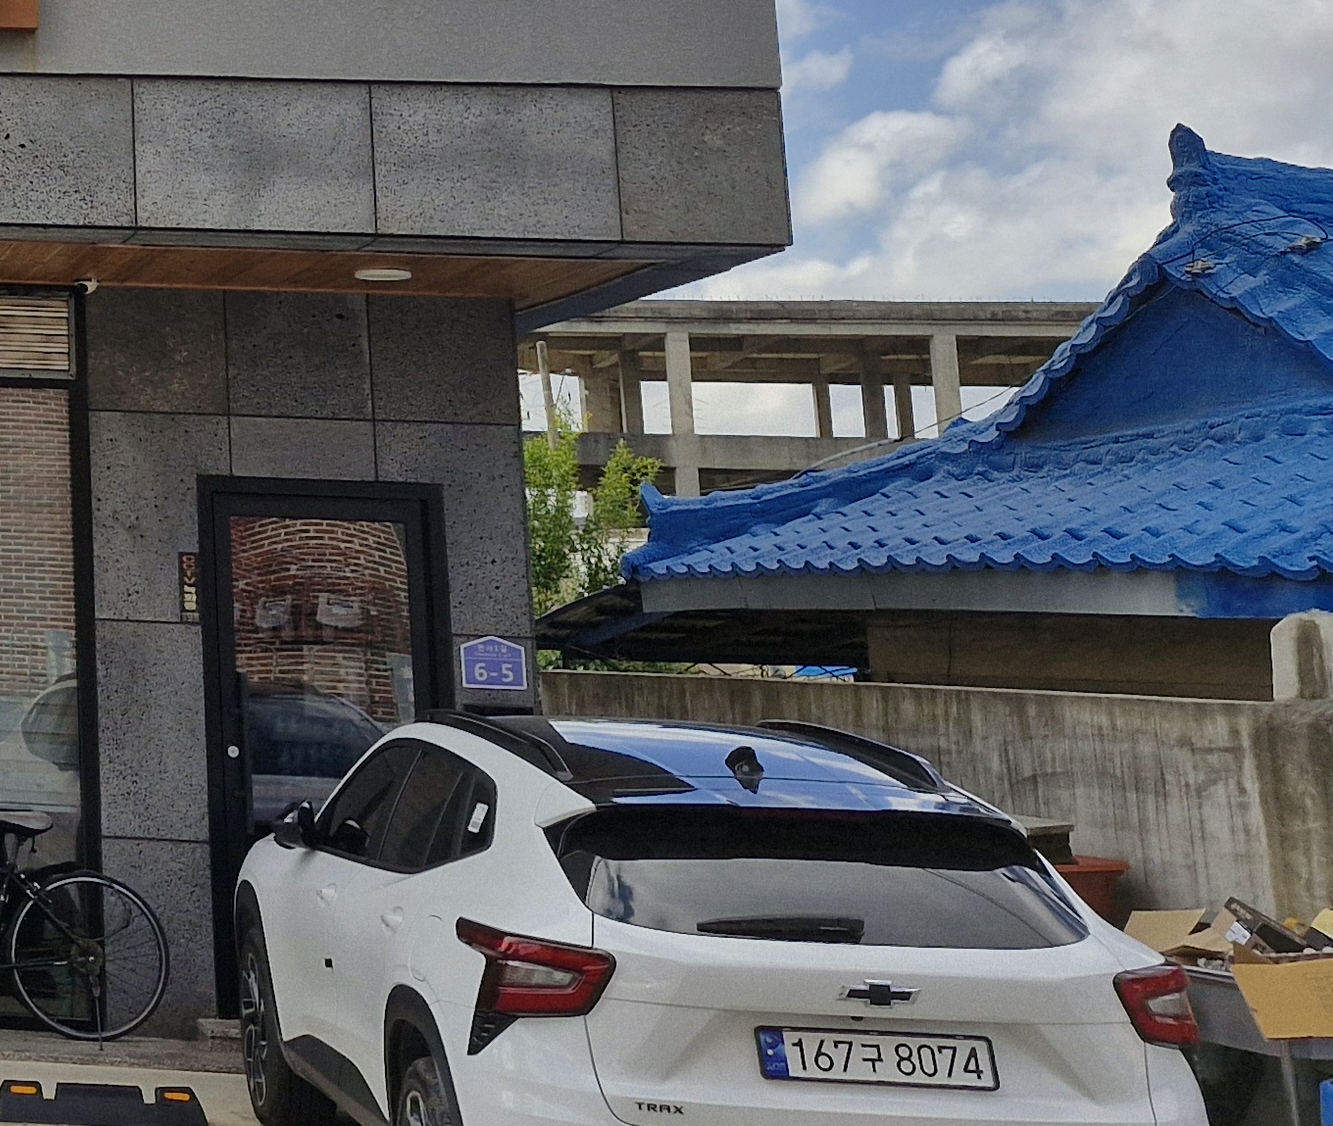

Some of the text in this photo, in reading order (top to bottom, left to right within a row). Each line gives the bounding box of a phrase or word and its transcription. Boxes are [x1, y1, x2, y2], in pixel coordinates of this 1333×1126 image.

[474, 662, 514, 683] 6-5
[791, 1037, 984, 1080] 167구 8074
[635, 1102, 684, 1115] TRAX
